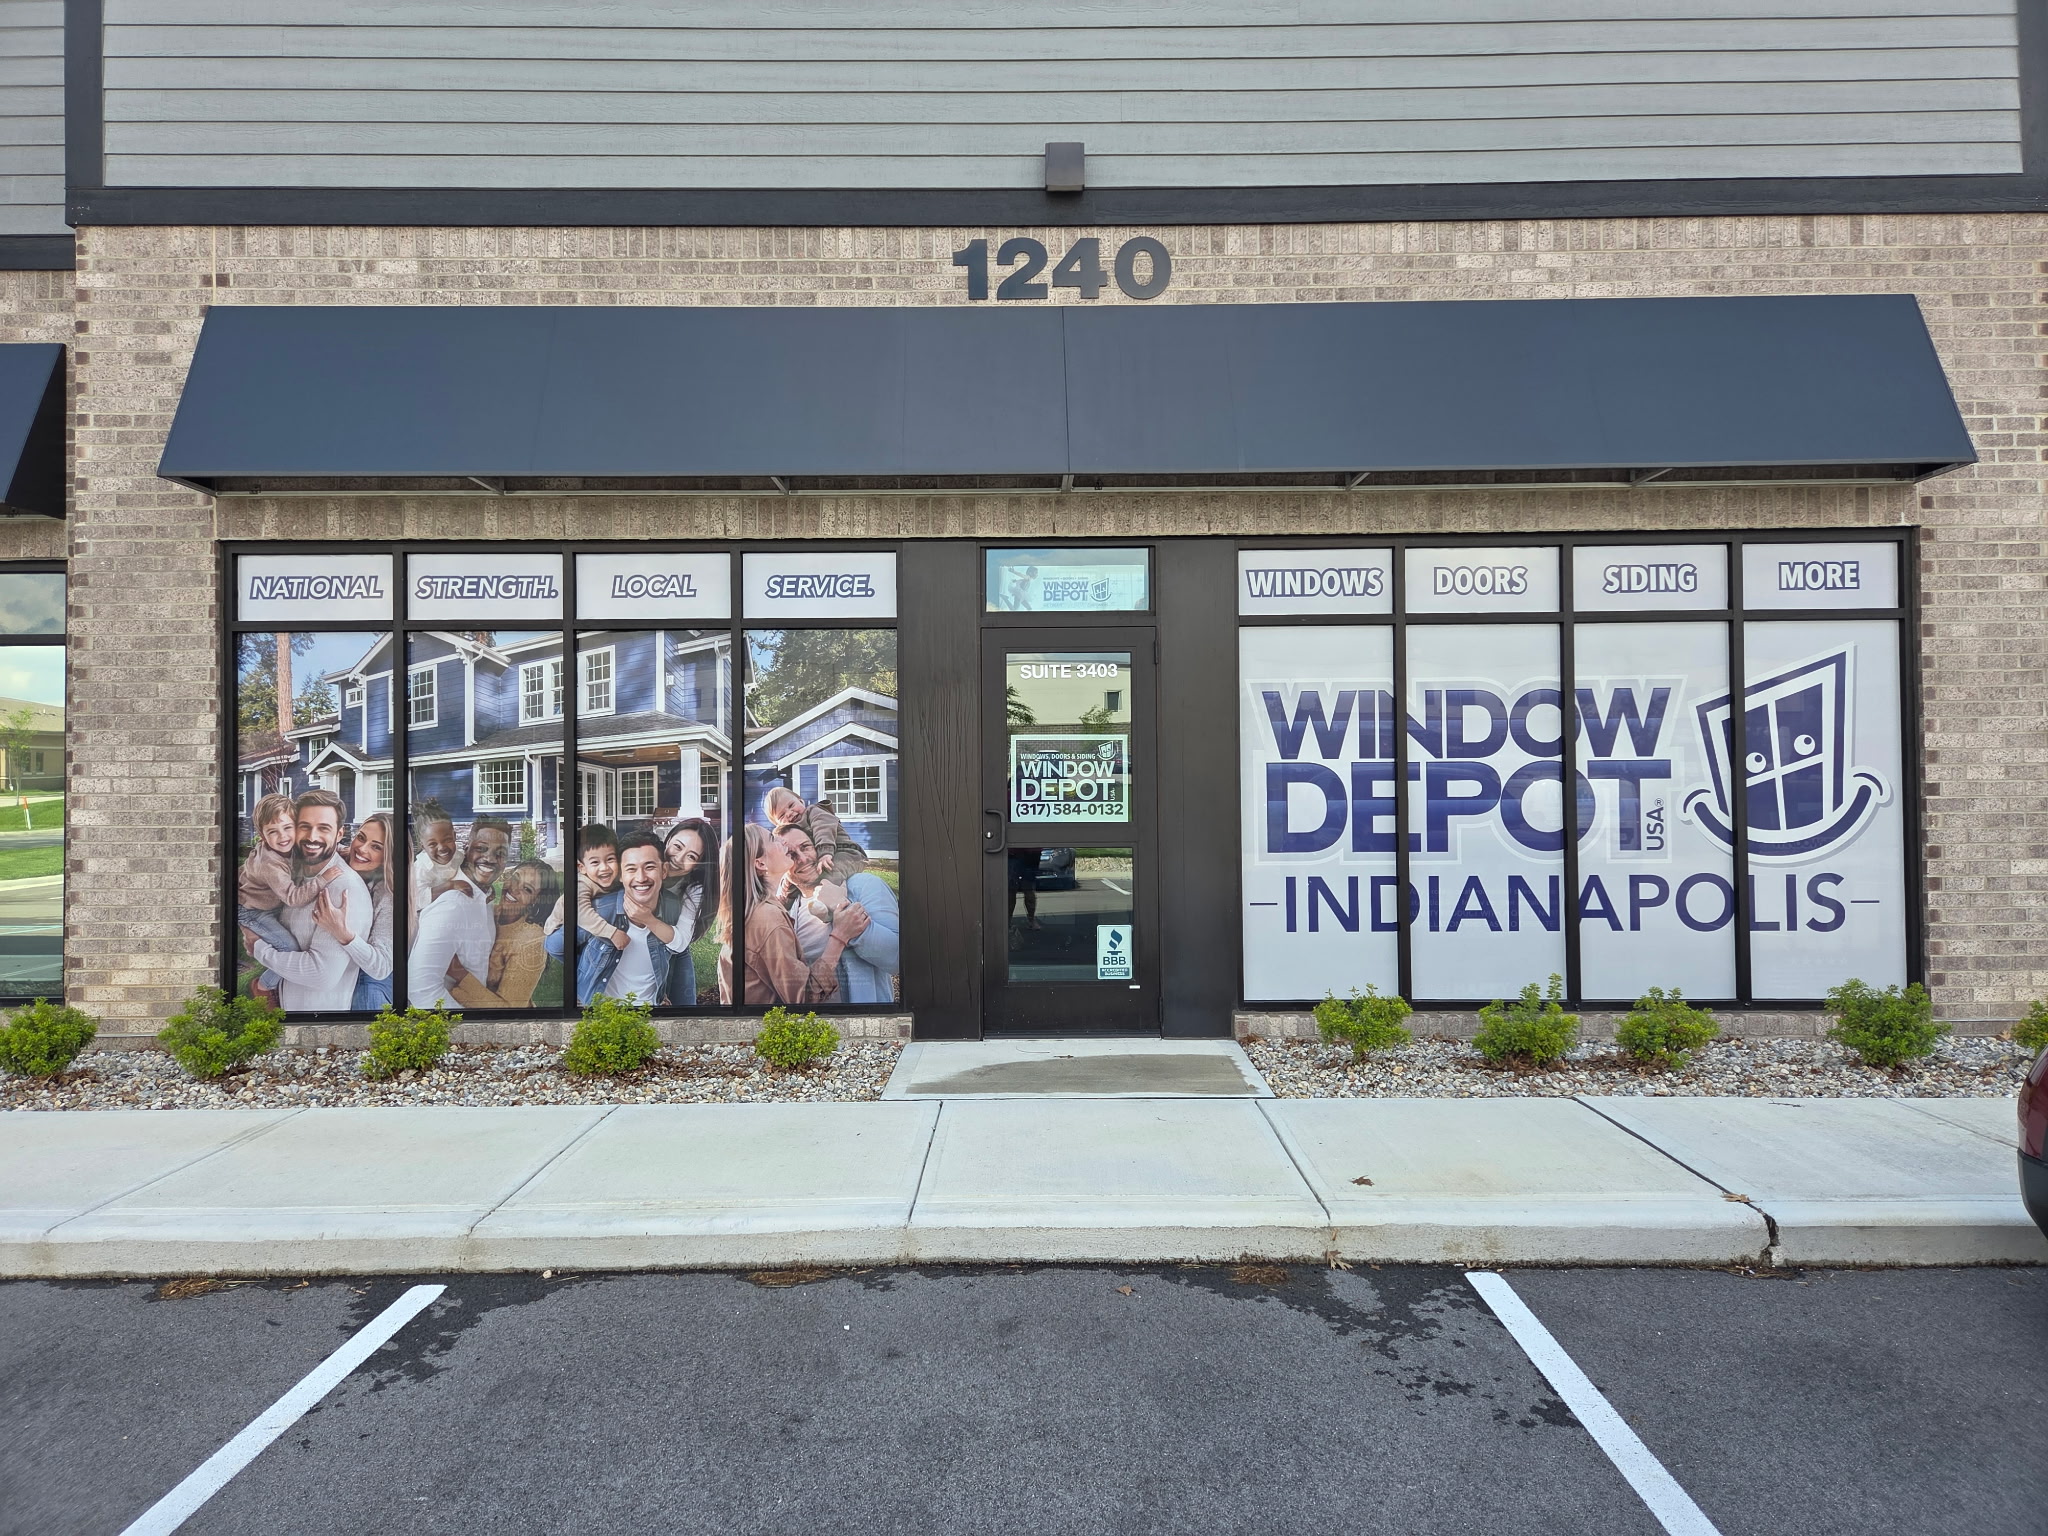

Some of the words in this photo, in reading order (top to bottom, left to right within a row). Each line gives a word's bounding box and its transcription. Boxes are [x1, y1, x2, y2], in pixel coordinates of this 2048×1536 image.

[953, 236, 1171, 300] 1240
[250, 575, 384, 599] NATIONAL
[415, 575, 558, 599] STRENGTH.
[611, 574, 697, 598] LOCAL
[765, 574, 875, 598] SERVICE.
[1043, 581, 1089, 590] WINDOW
[1245, 567, 1384, 597] WINDOWS
[1433, 565, 1528, 595] DOORS
[1602, 563, 1697, 593] SIDING
[1778, 561, 1860, 590] MORE
[1043, 590, 1089, 601] DEPOT
[1020, 664, 1072, 679] SUITE
[1076, 663, 1118, 678] 3403
[1262, 687, 1672, 759] WINDOW
[1020, 760, 1115, 777] WINDOW
[1021, 778, 1115, 800] DEPOT
[1016, 803, 1051, 817] (317)
[1053, 803, 1124, 816] 584-0132
[1266, 760, 1672, 853] DEPOT
[1286, 872, 1846, 932] INDIANAPOLIS
[1102, 956, 1126, 966] BBB
